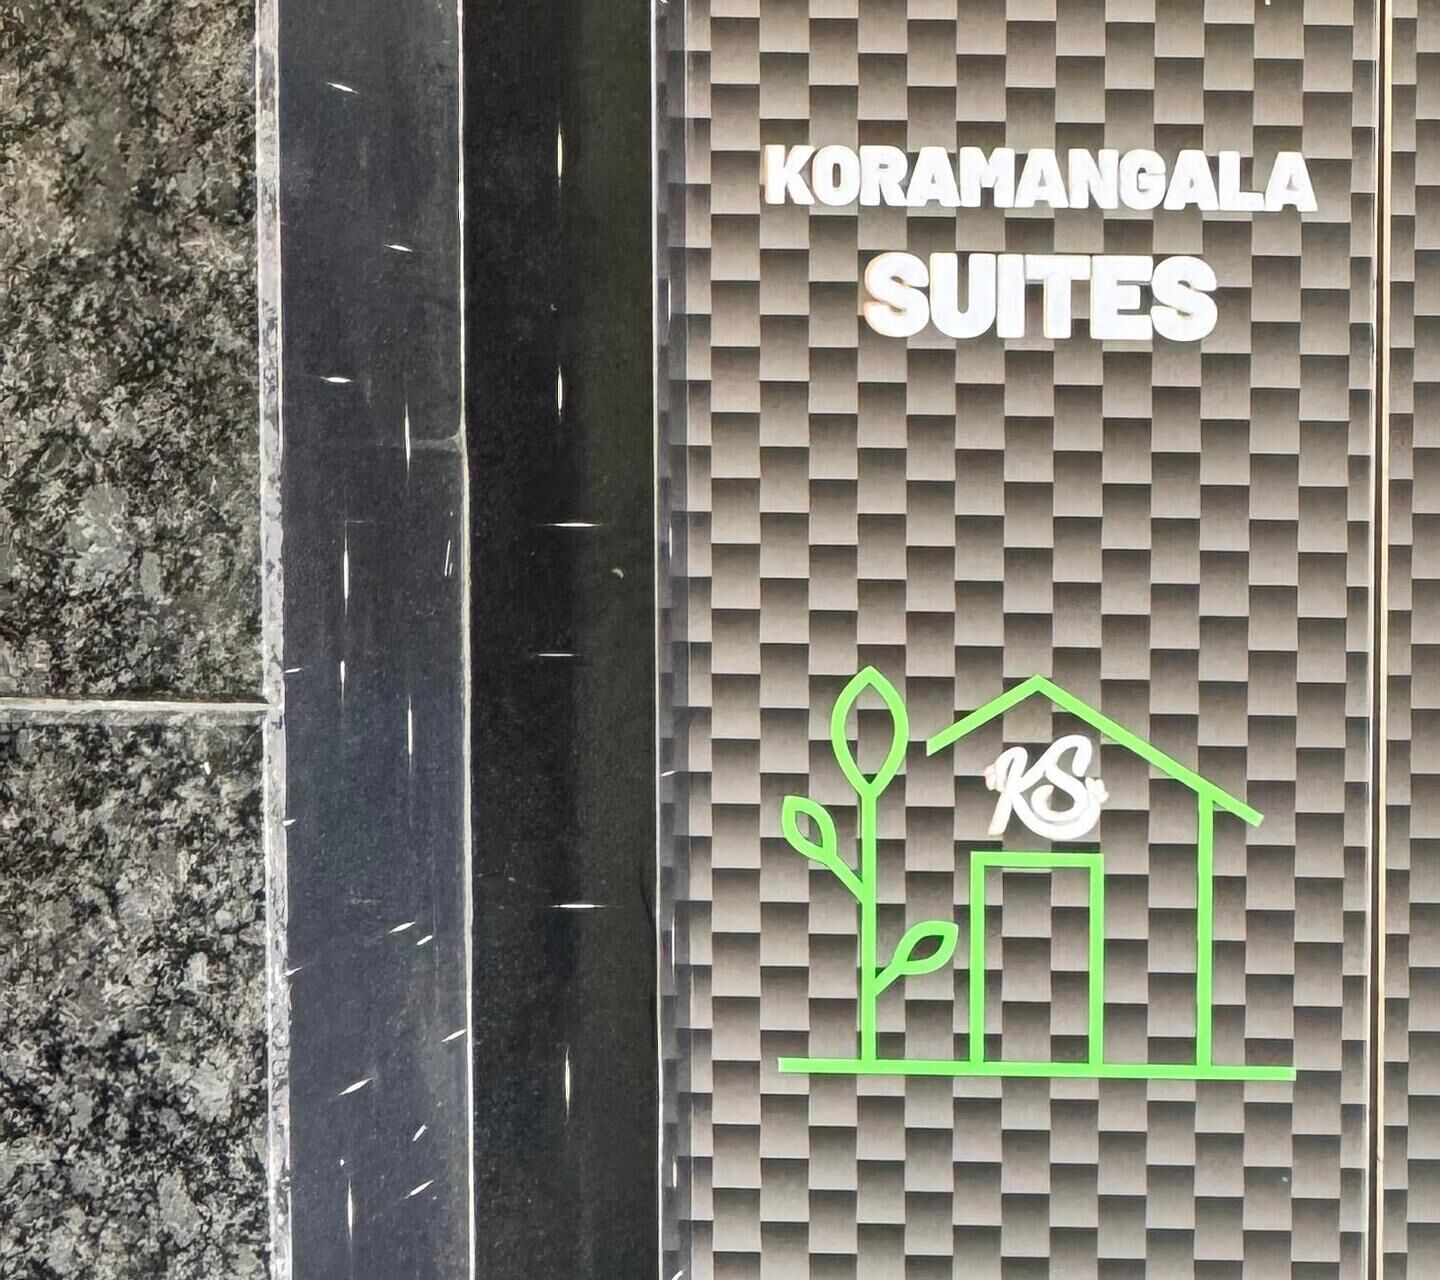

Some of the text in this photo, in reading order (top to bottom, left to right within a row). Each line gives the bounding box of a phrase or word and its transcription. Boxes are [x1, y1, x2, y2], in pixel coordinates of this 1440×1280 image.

[763, 144, 1318, 212] KORAMANGALA
[863, 251, 1218, 341] SUITES
[984, 734, 1109, 840] KS
